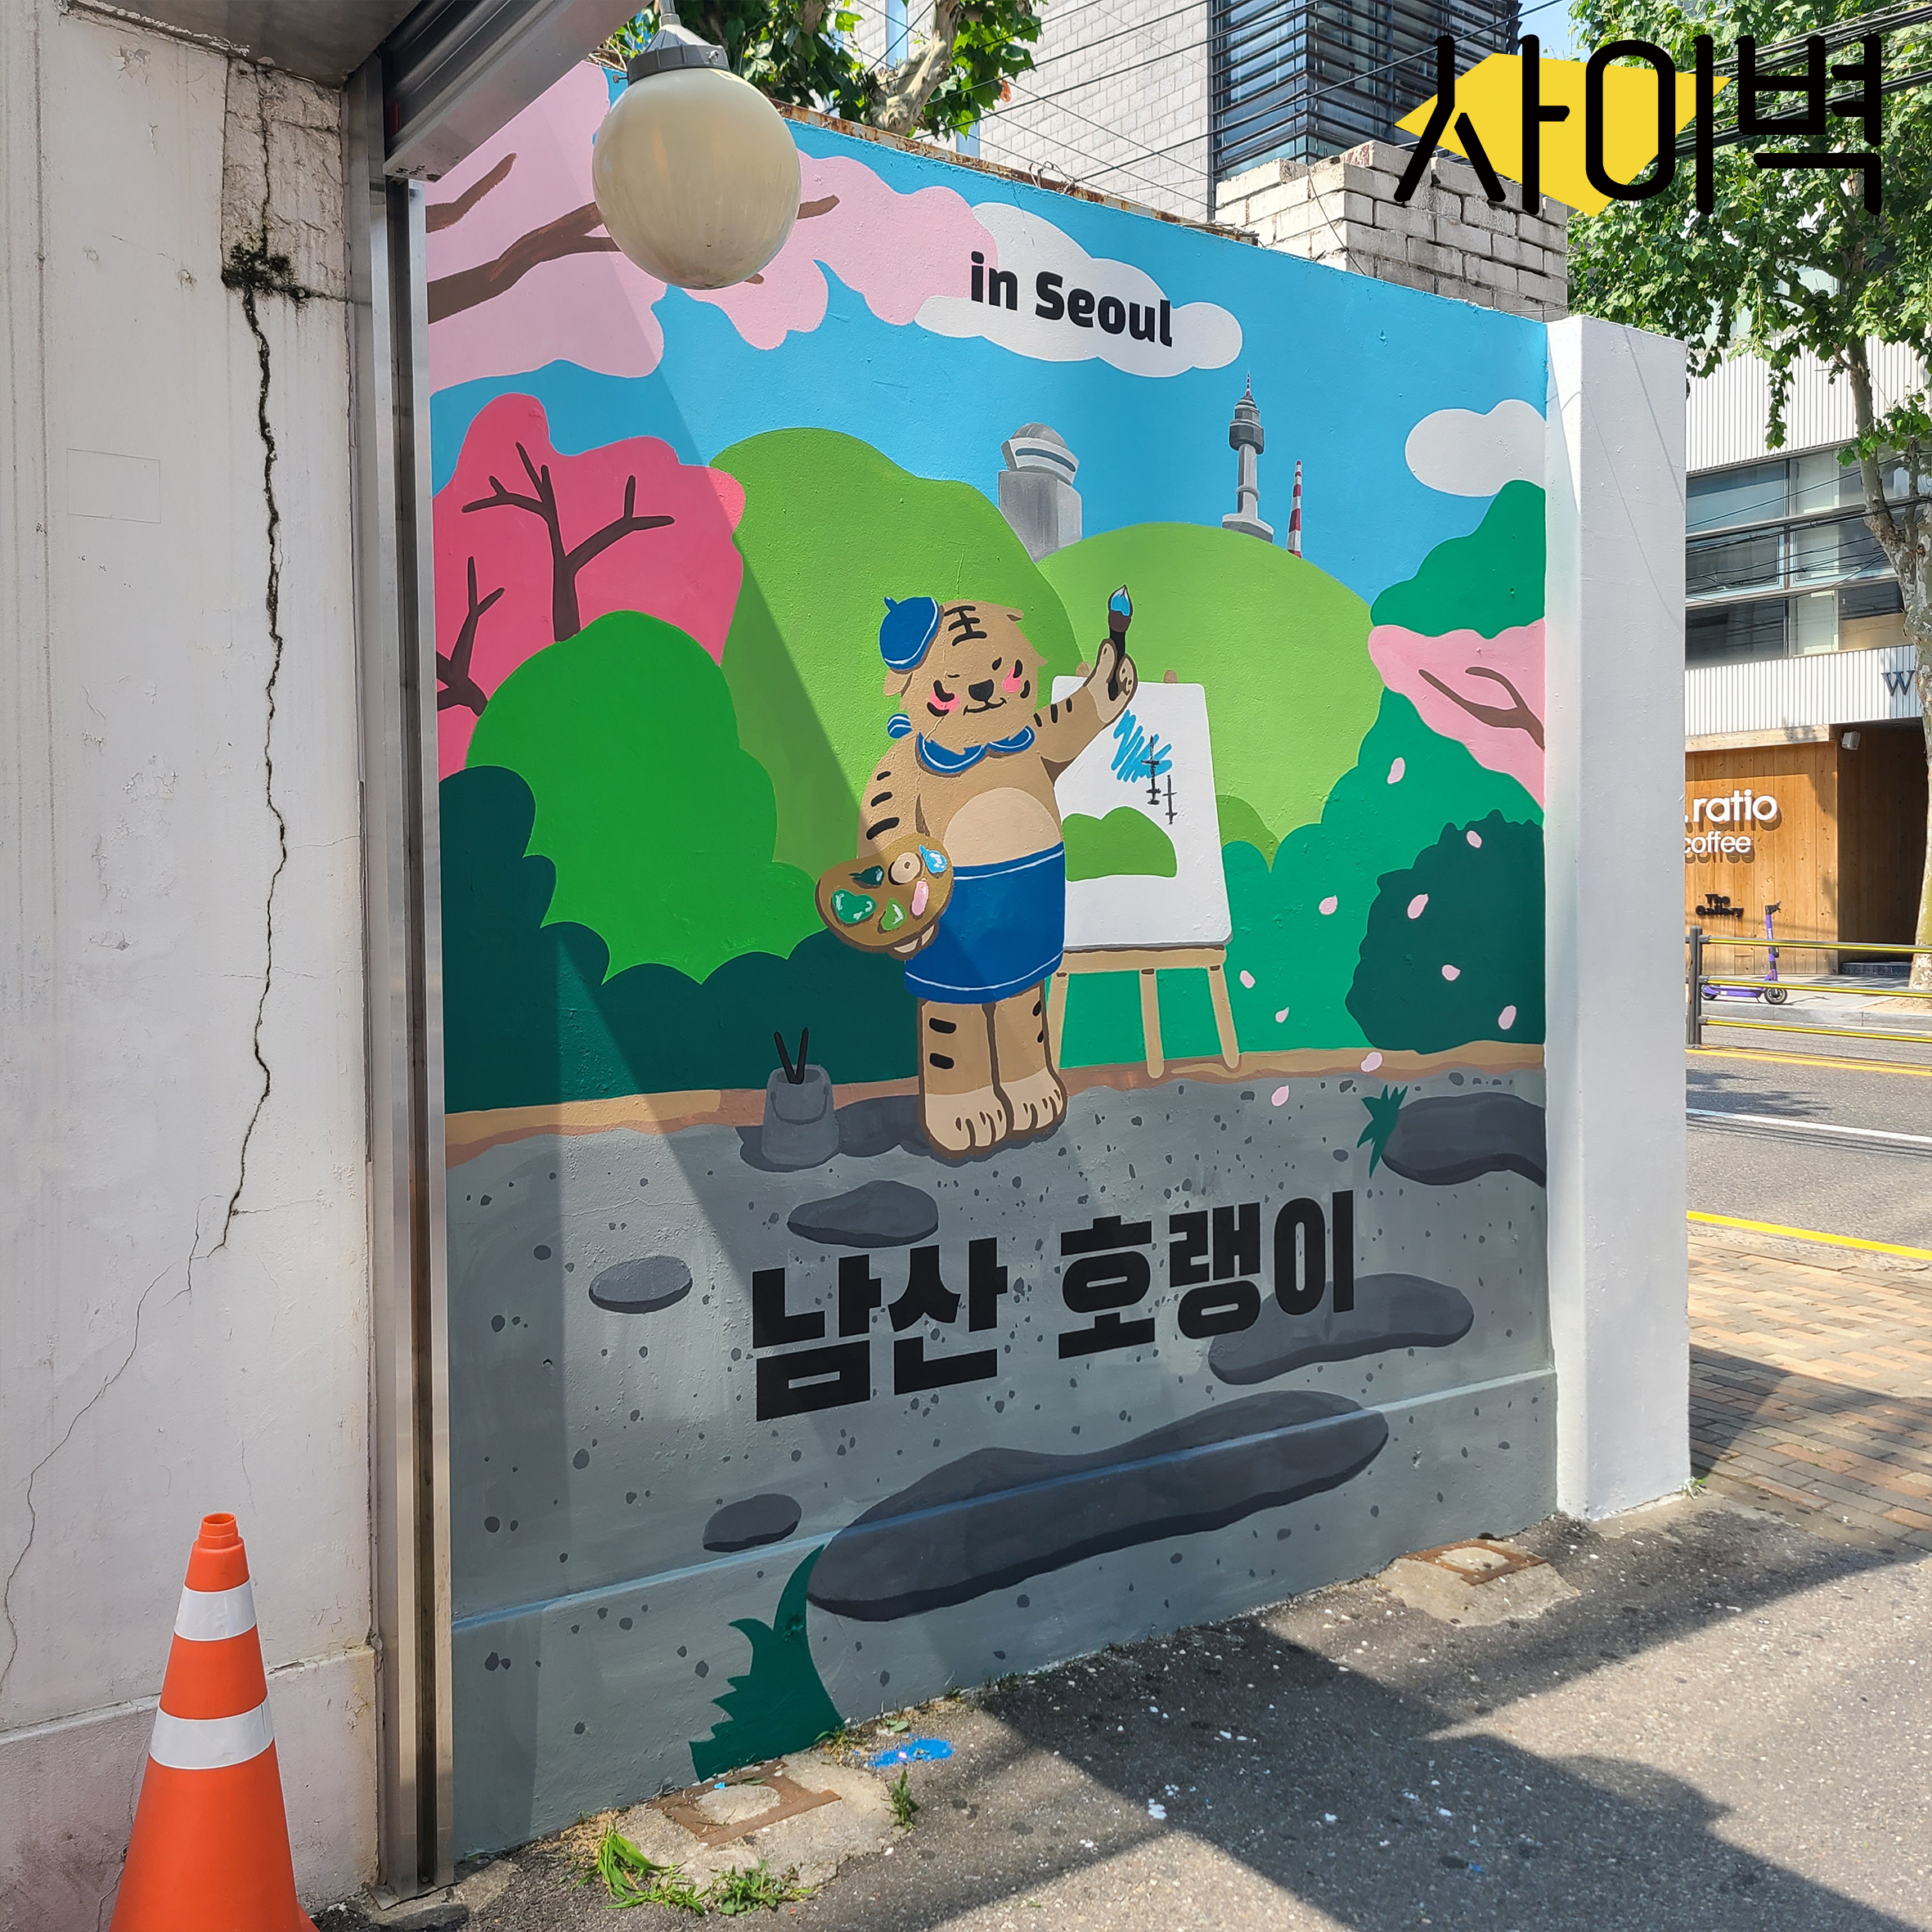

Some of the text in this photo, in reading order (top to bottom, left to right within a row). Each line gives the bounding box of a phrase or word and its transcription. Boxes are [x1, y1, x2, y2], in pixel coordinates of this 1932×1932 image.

[971, 250, 1172, 347] in Seoul
[752, 1190, 1355, 1422] 남산 호랭이
